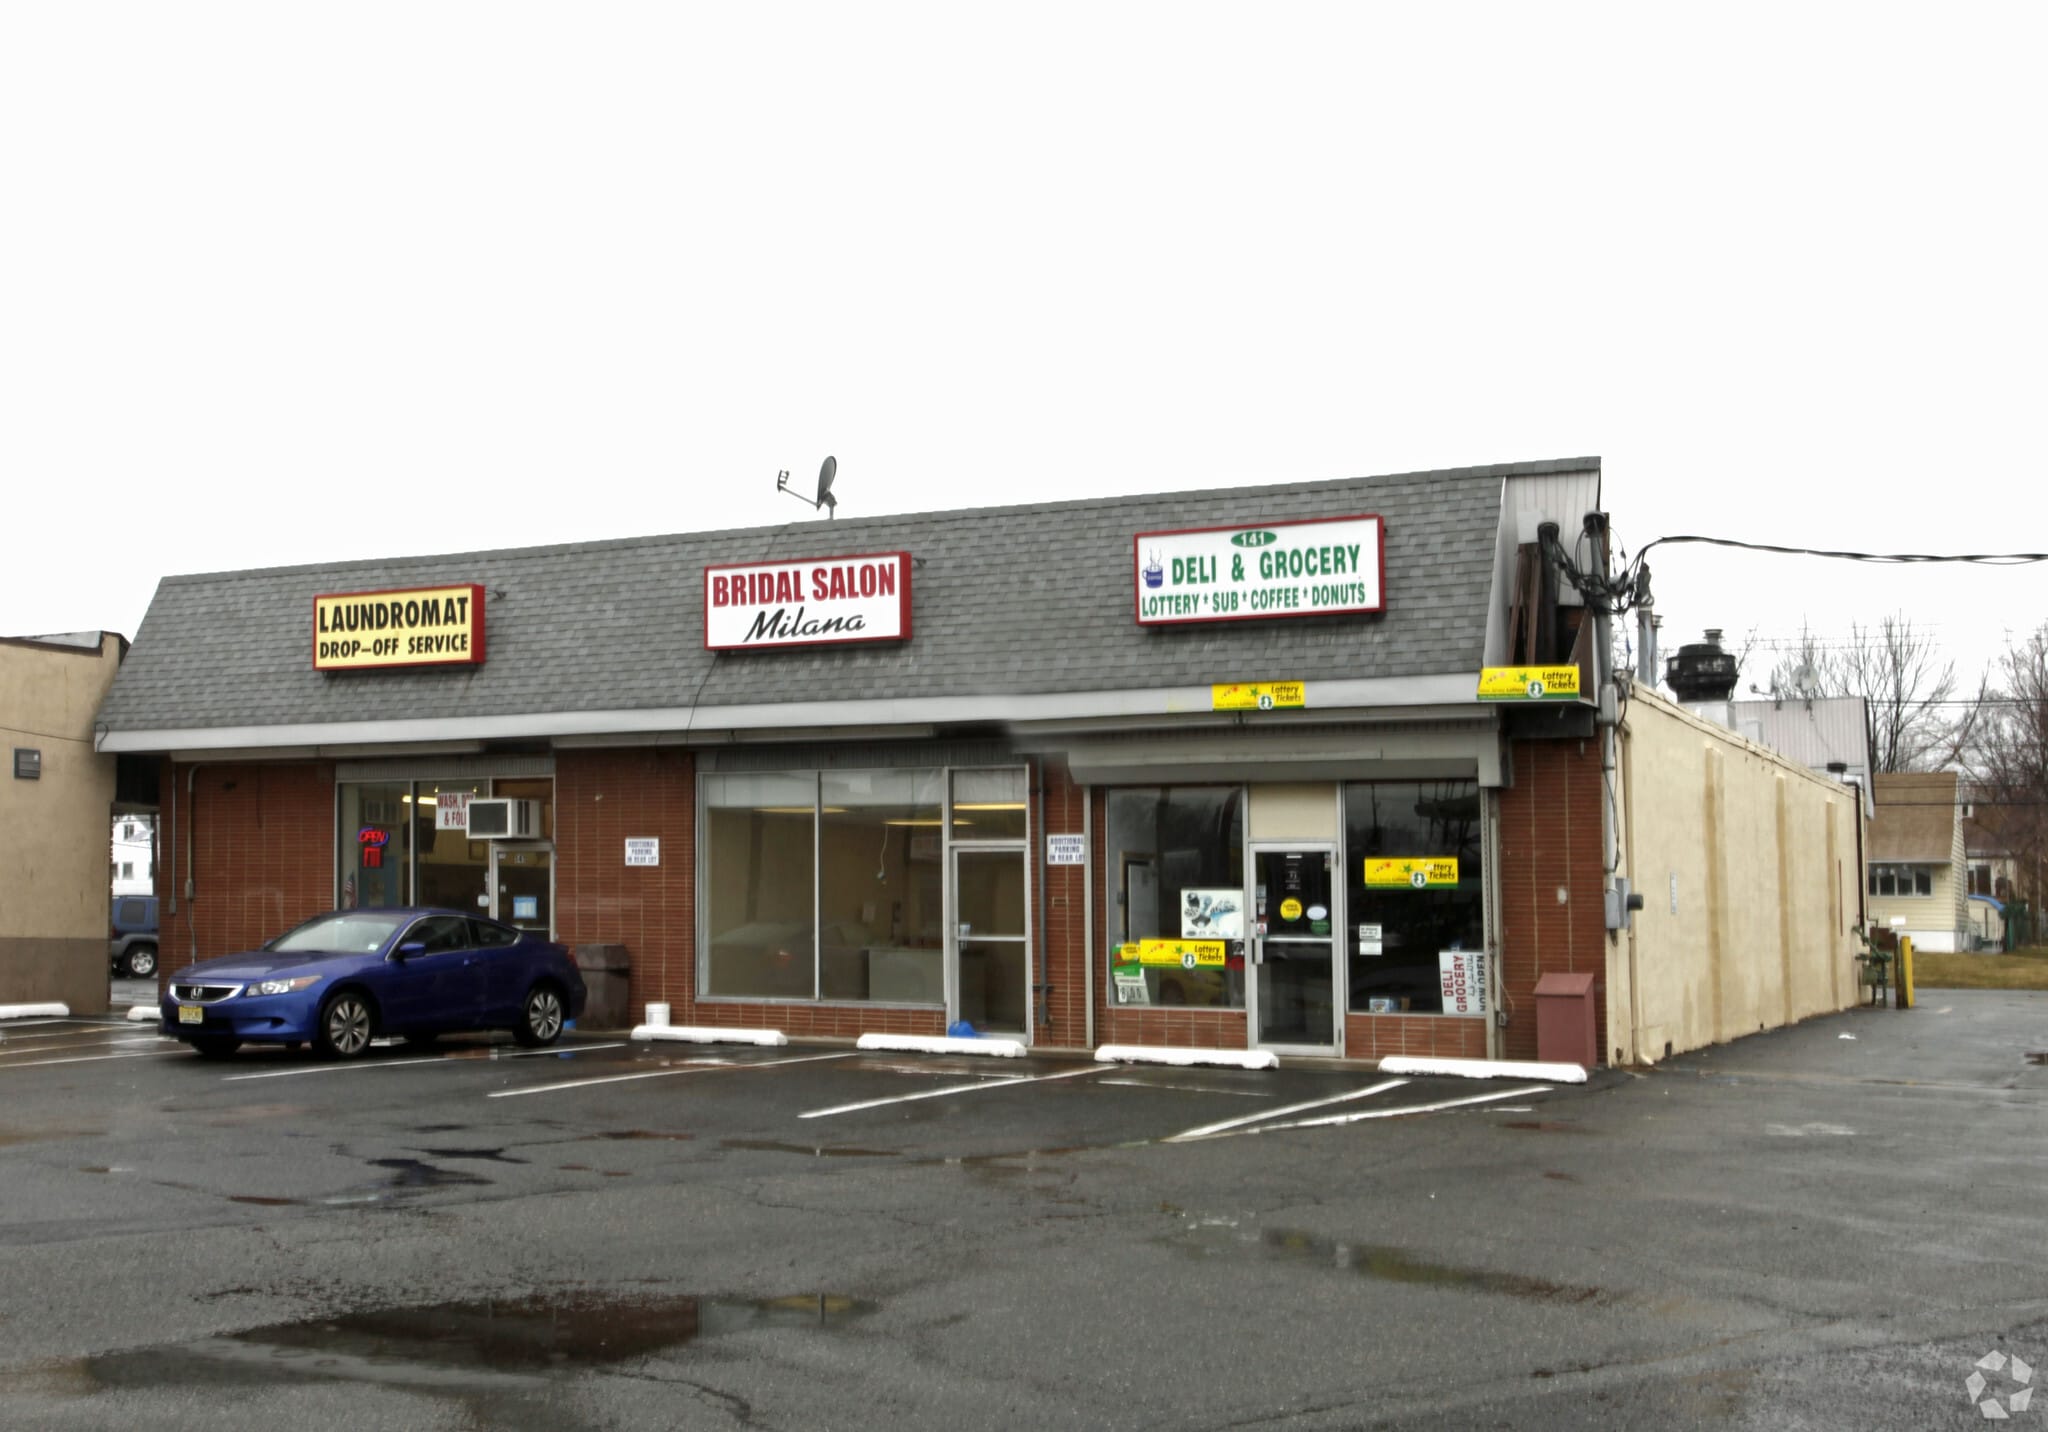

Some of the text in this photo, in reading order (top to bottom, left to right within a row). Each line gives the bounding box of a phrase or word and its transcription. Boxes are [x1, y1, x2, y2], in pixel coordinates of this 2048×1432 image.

[1240, 532, 1265, 546] 141
[1172, 544, 1361, 585] DELI & GROCERY
[713, 563, 895, 607] BRIDAL SALON
[1142, 582, 1366, 617] LOTTERY SUB COFFEE DONUTS
[319, 597, 468, 633] LAUNDROMAT
[743, 606, 866, 643] Milana
[319, 633, 468, 659] DROP-OFF SERVICE
[1542, 671, 1573, 682] Lottery
[1271, 685, 1299, 696] Lottery
[1548, 680, 1576, 689] Tickets
[1276, 694, 1301, 703] Tickets
[452, 811, 467, 826] FOL
[1424, 862, 1453, 872] ttery
[1429, 871, 1455, 880] Tickets
[1195, 945, 1220, 955] Lottery
[1199, 953, 1222, 961] Tickets
[1476, 955, 1486, 984] OPEN
[1442, 970, 1454, 997] DELI
[1453, 955, 1468, 1012] GROCERY
